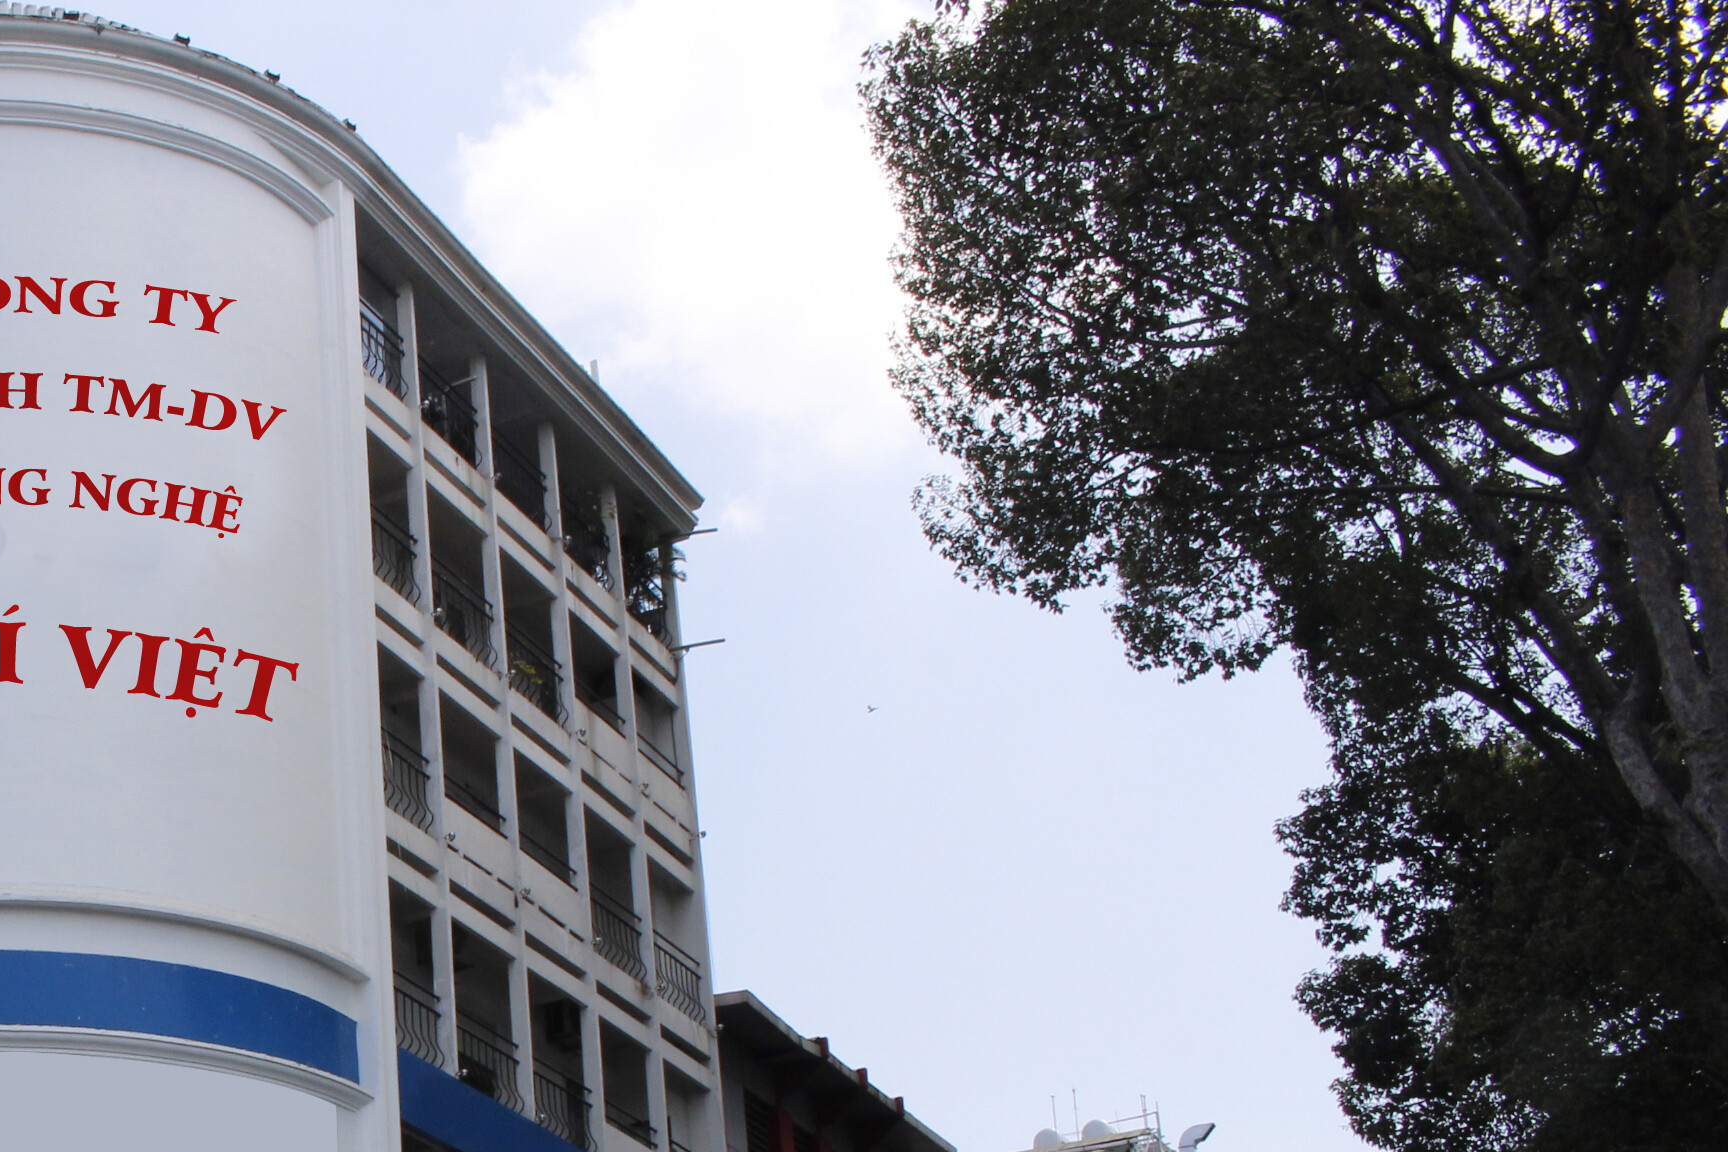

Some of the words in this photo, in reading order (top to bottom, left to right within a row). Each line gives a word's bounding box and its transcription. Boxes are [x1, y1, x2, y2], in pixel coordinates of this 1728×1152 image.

[144, 284, 238, 334] TY
[63, 373, 287, 441] TM-DV
[69, 471, 244, 539] NGHỆ
[58, 624, 300, 722] VIỆT
